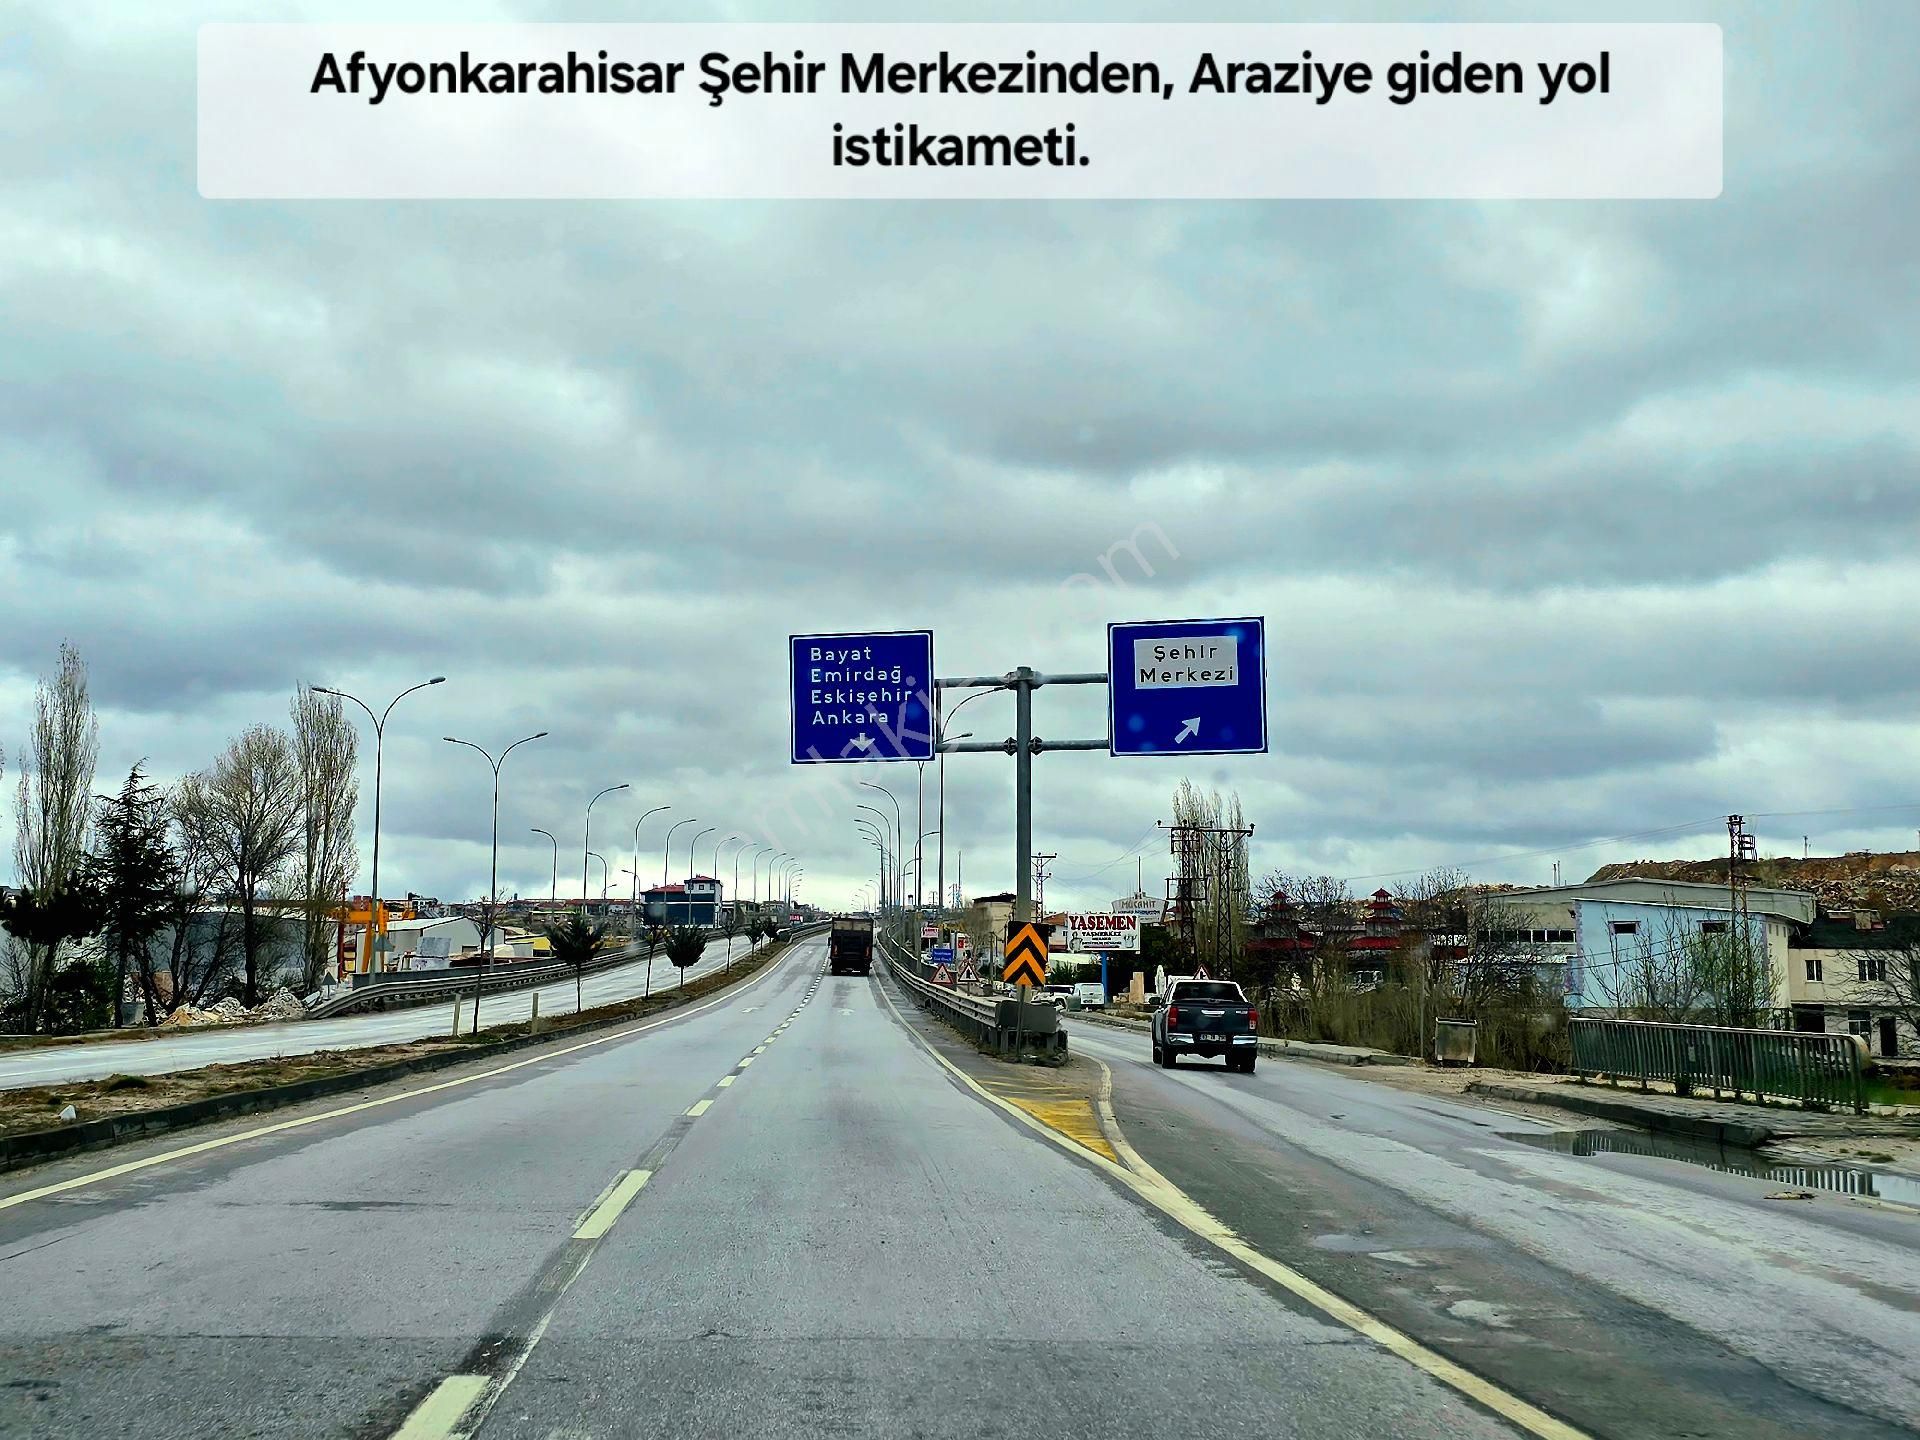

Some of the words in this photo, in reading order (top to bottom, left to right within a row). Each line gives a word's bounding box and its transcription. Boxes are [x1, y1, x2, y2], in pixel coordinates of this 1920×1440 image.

[810, 647, 871, 664] Bayat
[1153, 645, 1217, 662] Şehir
[811, 666, 900, 683] Emirdağ
[1140, 666, 1233, 682] Merkezi
[811, 688, 912, 704] Eskişehir
[812, 710, 888, 725] Ankara
[1069, 915, 1137, 930] YASEMEN
